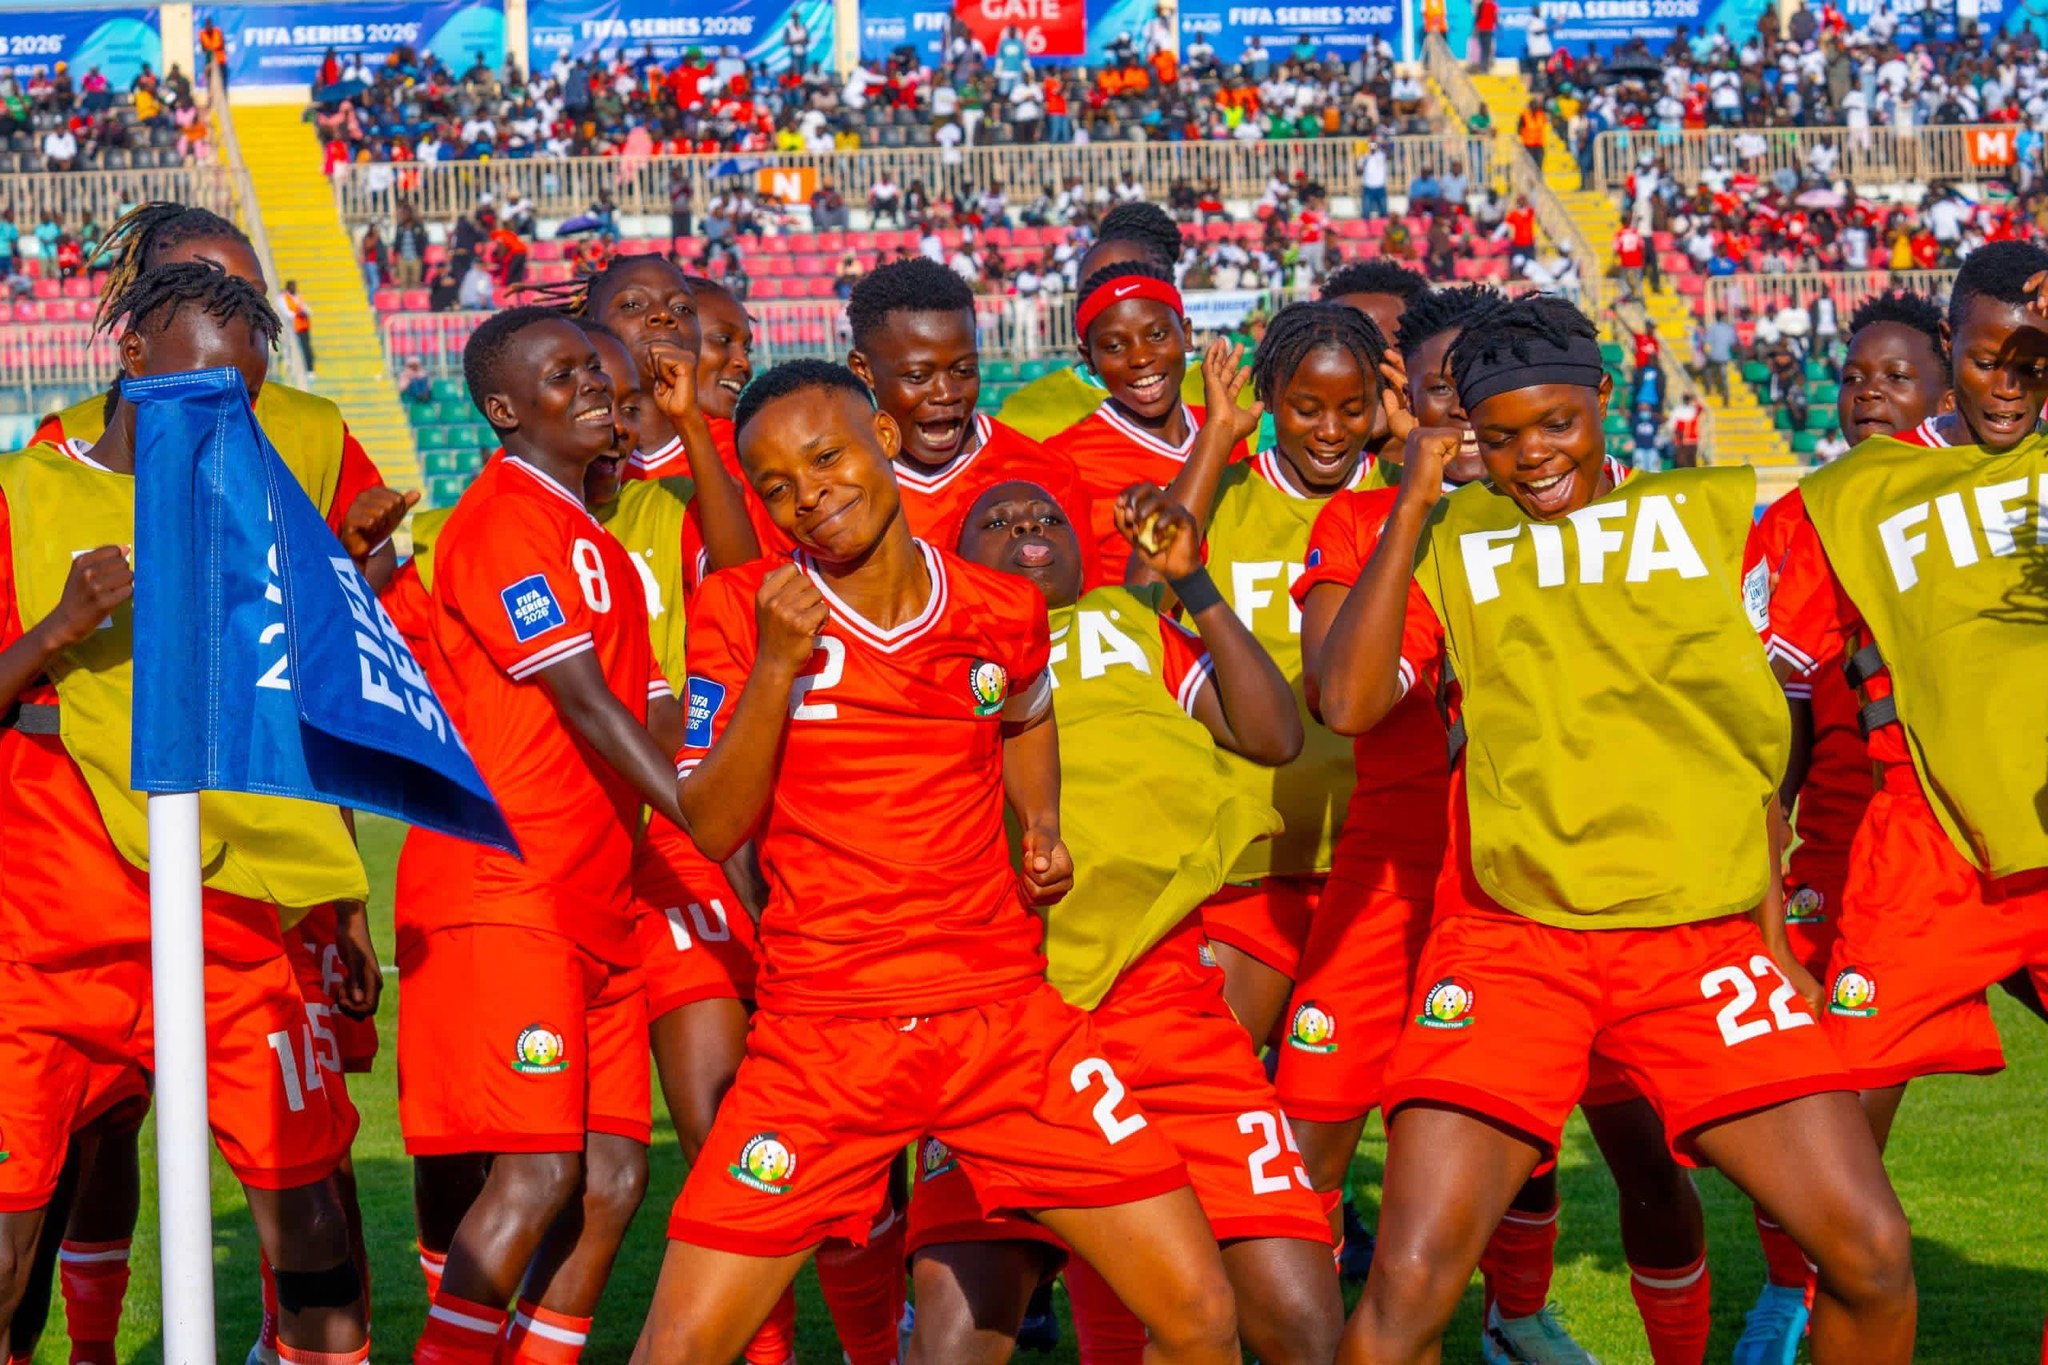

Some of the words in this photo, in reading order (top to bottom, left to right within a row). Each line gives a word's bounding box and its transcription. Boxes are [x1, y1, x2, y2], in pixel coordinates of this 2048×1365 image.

[980, 0, 1061, 20] GATE
[1228, 7, 1274, 25] FIFA
[1275, 6, 1343, 25] SERIES
[1345, 5, 1394, 24] 2026
[1584, 0, 1651, 18] SERIES
[243, 27, 292, 46] FIFA
[292, 24, 364, 45] SERIES
[366, 22, 417, 43] 2026
[581, 19, 629, 38] FIFA
[629, 17, 700, 36] SERIES
[702, 16, 753, 35] 2026
[10, 34, 62, 55] 2026
[1977, 132, 2007, 160] M
[773, 172, 801, 202] N
[1878, 473, 2048, 593] FIF
[1459, 494, 1709, 604] FIFA
[572, 538, 611, 613] 8
[515, 595, 550, 619] SERIES
[516, 589, 541, 607] FIFA
[523, 606, 549, 626] 2026
[328, 556, 407, 715] FIFA
[789, 635, 845, 720] 2
[970, 668, 985, 704] FOOTBALL
[1425, 983, 1442, 1016] FOOTBALL
[1700, 954, 1815, 1047] 22
[1424, 1020, 1463, 1029] FEDERATION
[1070, 1057, 1148, 1145] 2
[741, 1134, 764, 1169] FOOTBALL
[737, 1172, 781, 1194] FEDERATION
